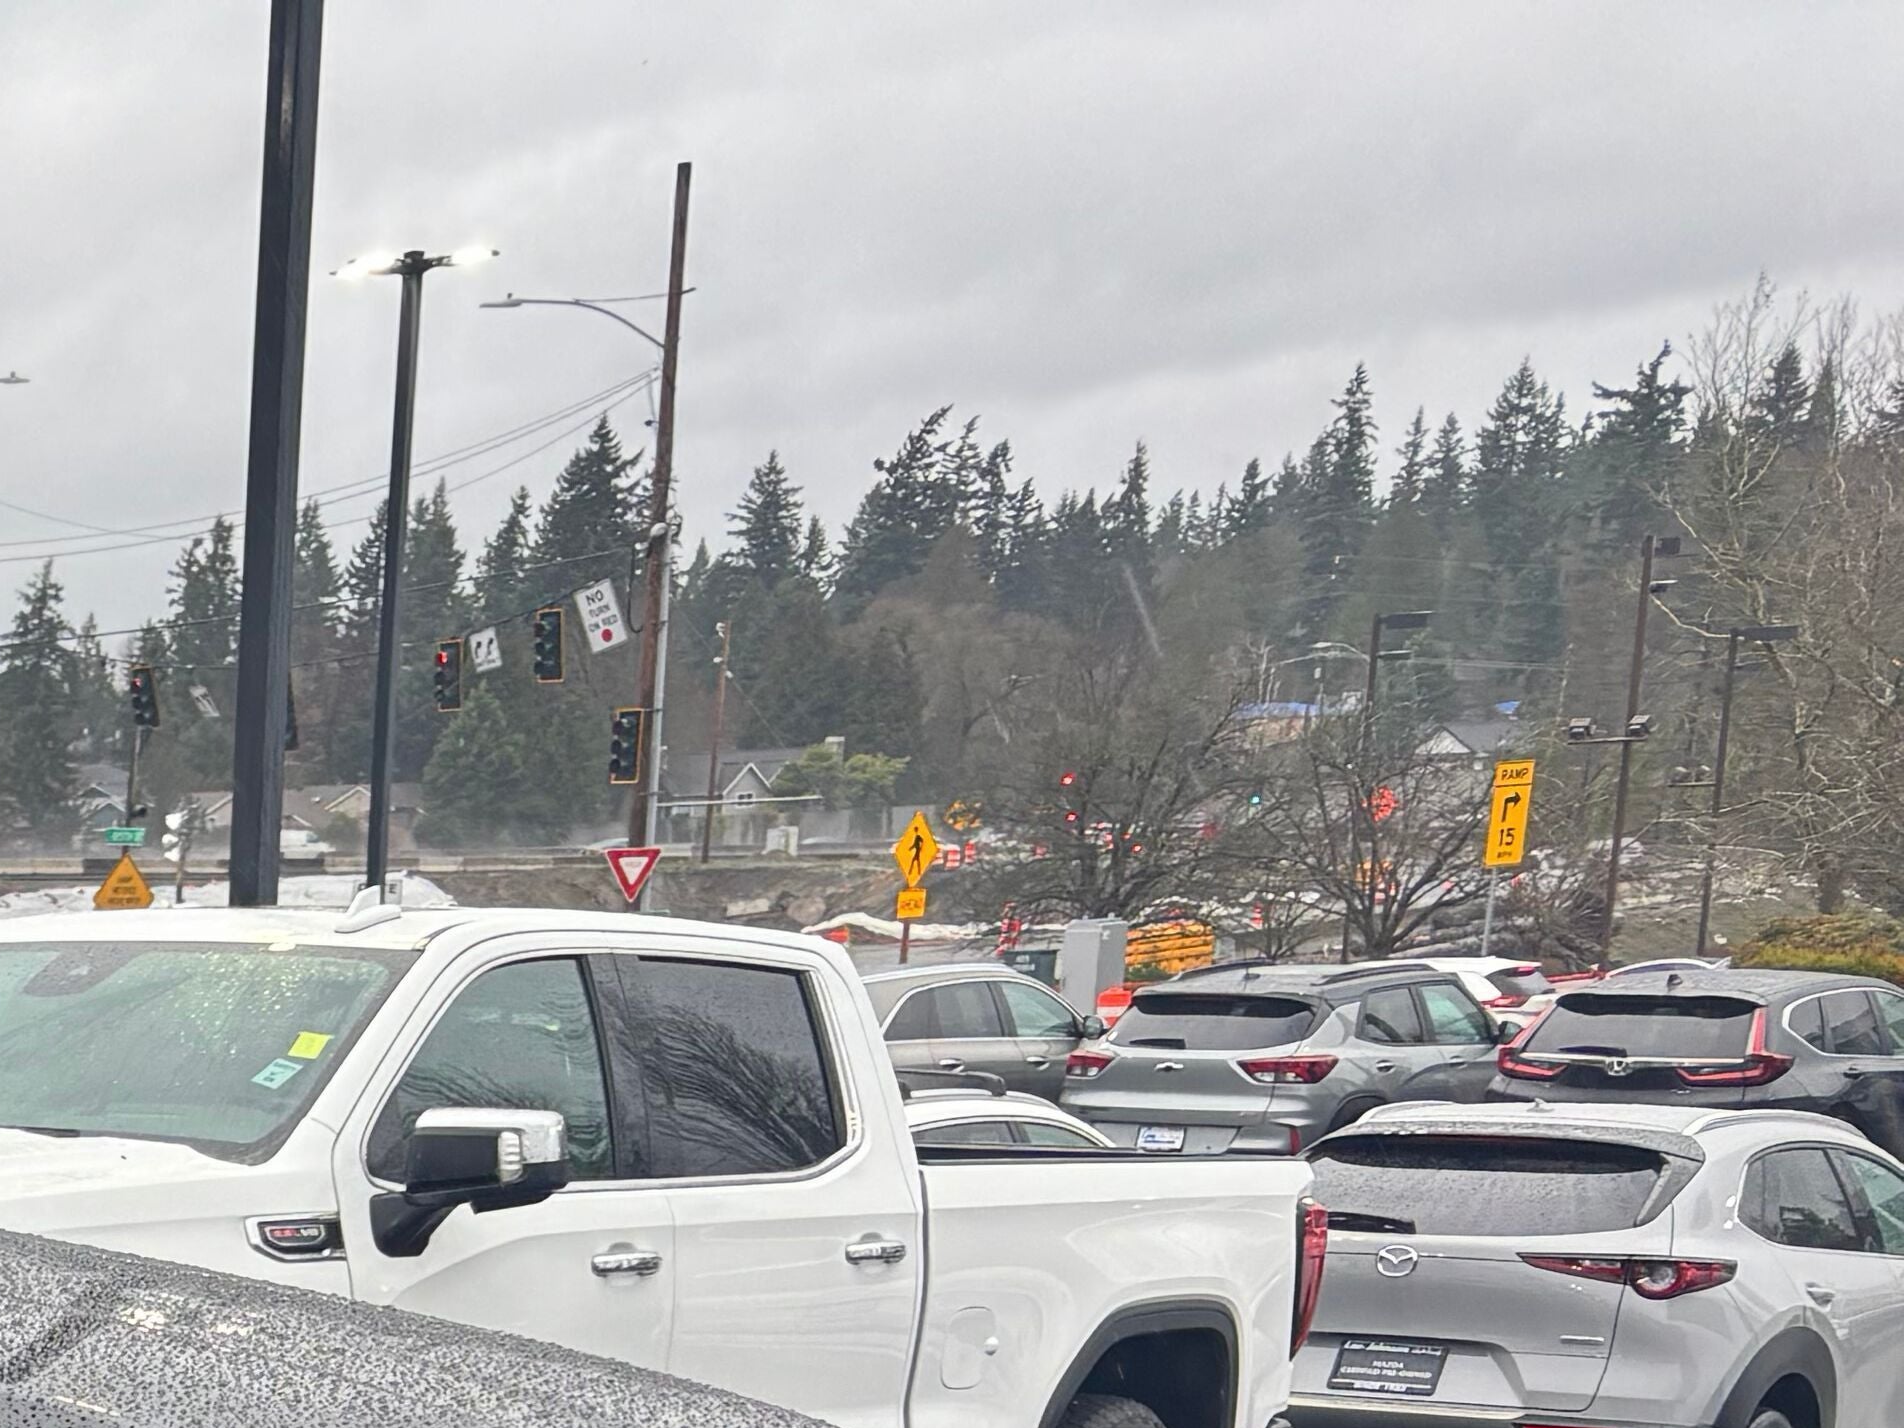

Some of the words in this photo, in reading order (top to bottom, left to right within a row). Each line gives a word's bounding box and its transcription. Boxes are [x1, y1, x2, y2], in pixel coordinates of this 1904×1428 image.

[585, 589, 604, 606] NO
[1501, 768, 1529, 780] RAMP
[1499, 828, 1515, 846] 15
